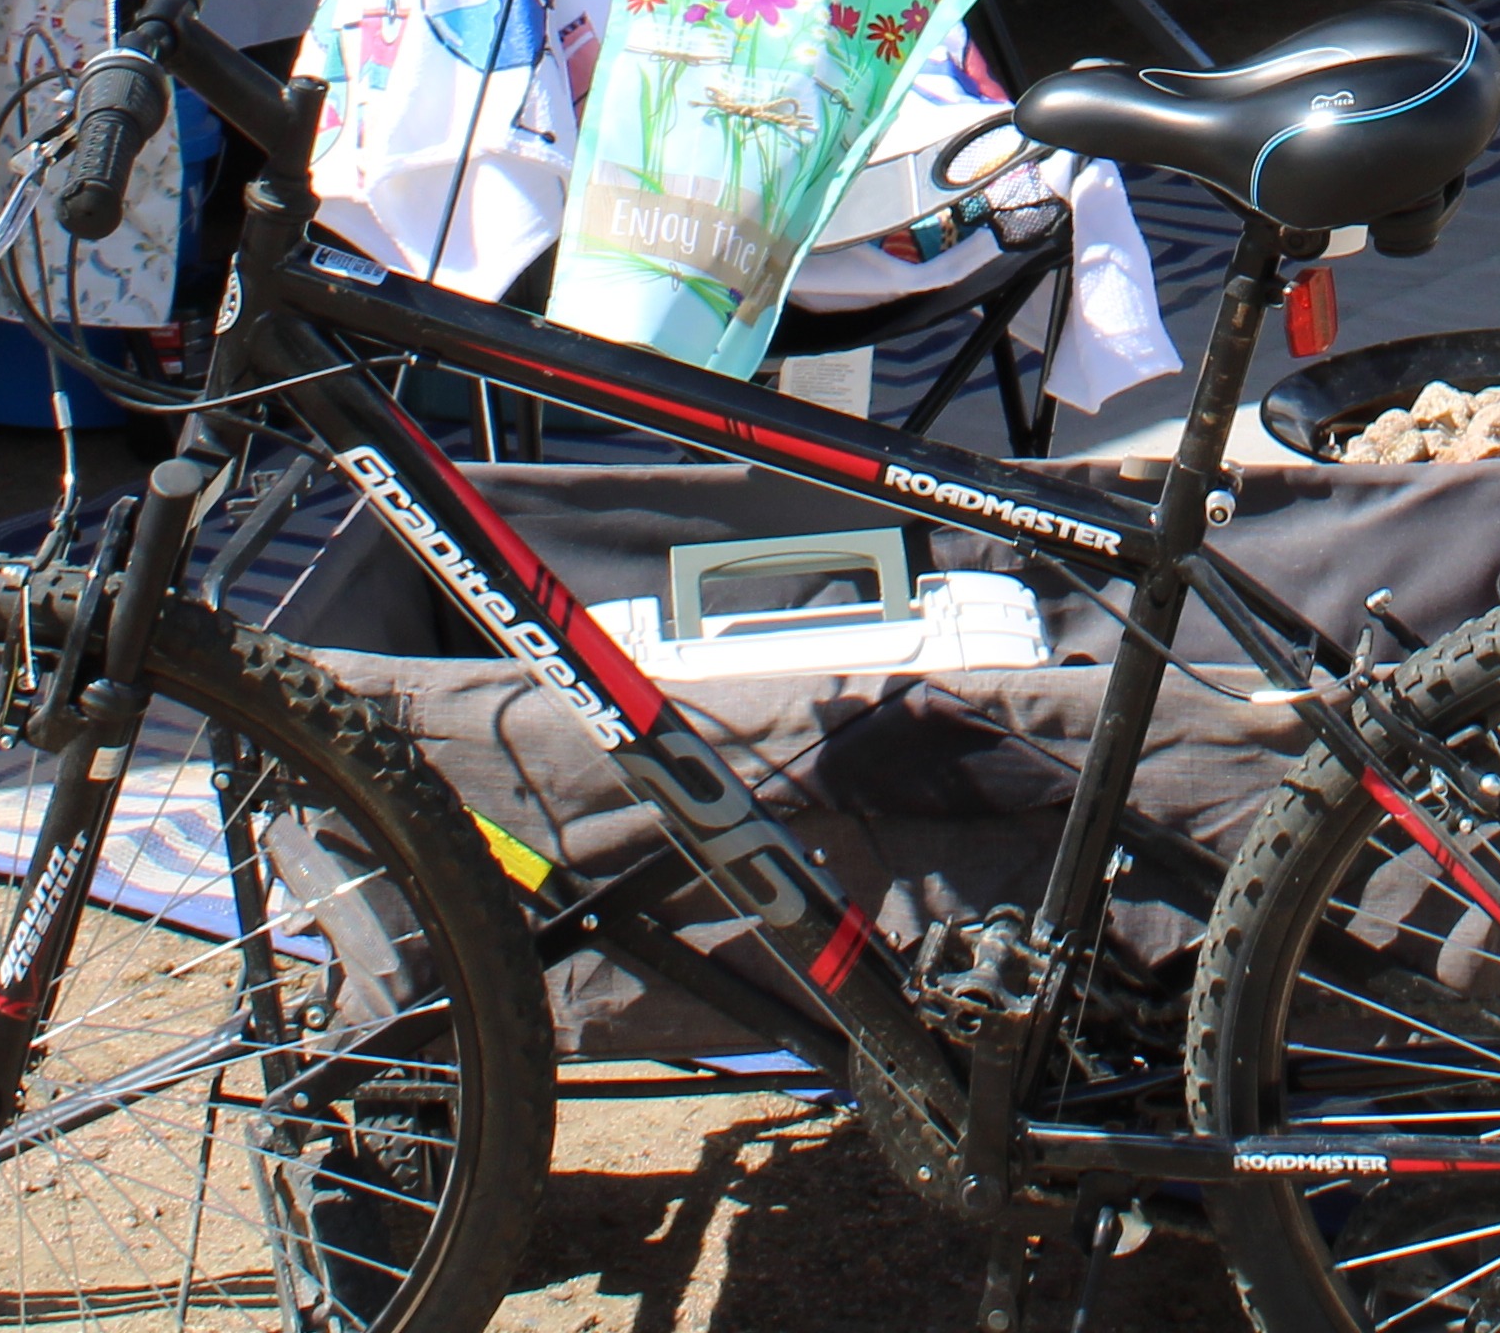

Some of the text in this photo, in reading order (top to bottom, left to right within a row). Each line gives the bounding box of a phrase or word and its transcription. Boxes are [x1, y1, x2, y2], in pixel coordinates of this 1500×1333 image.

[711, 219, 757, 275] the
[884, 463, 1123, 556] ROADMASTER
[0, 844, 46, 990] ground
[1232, 1153, 1389, 1173] ROADMASTER
